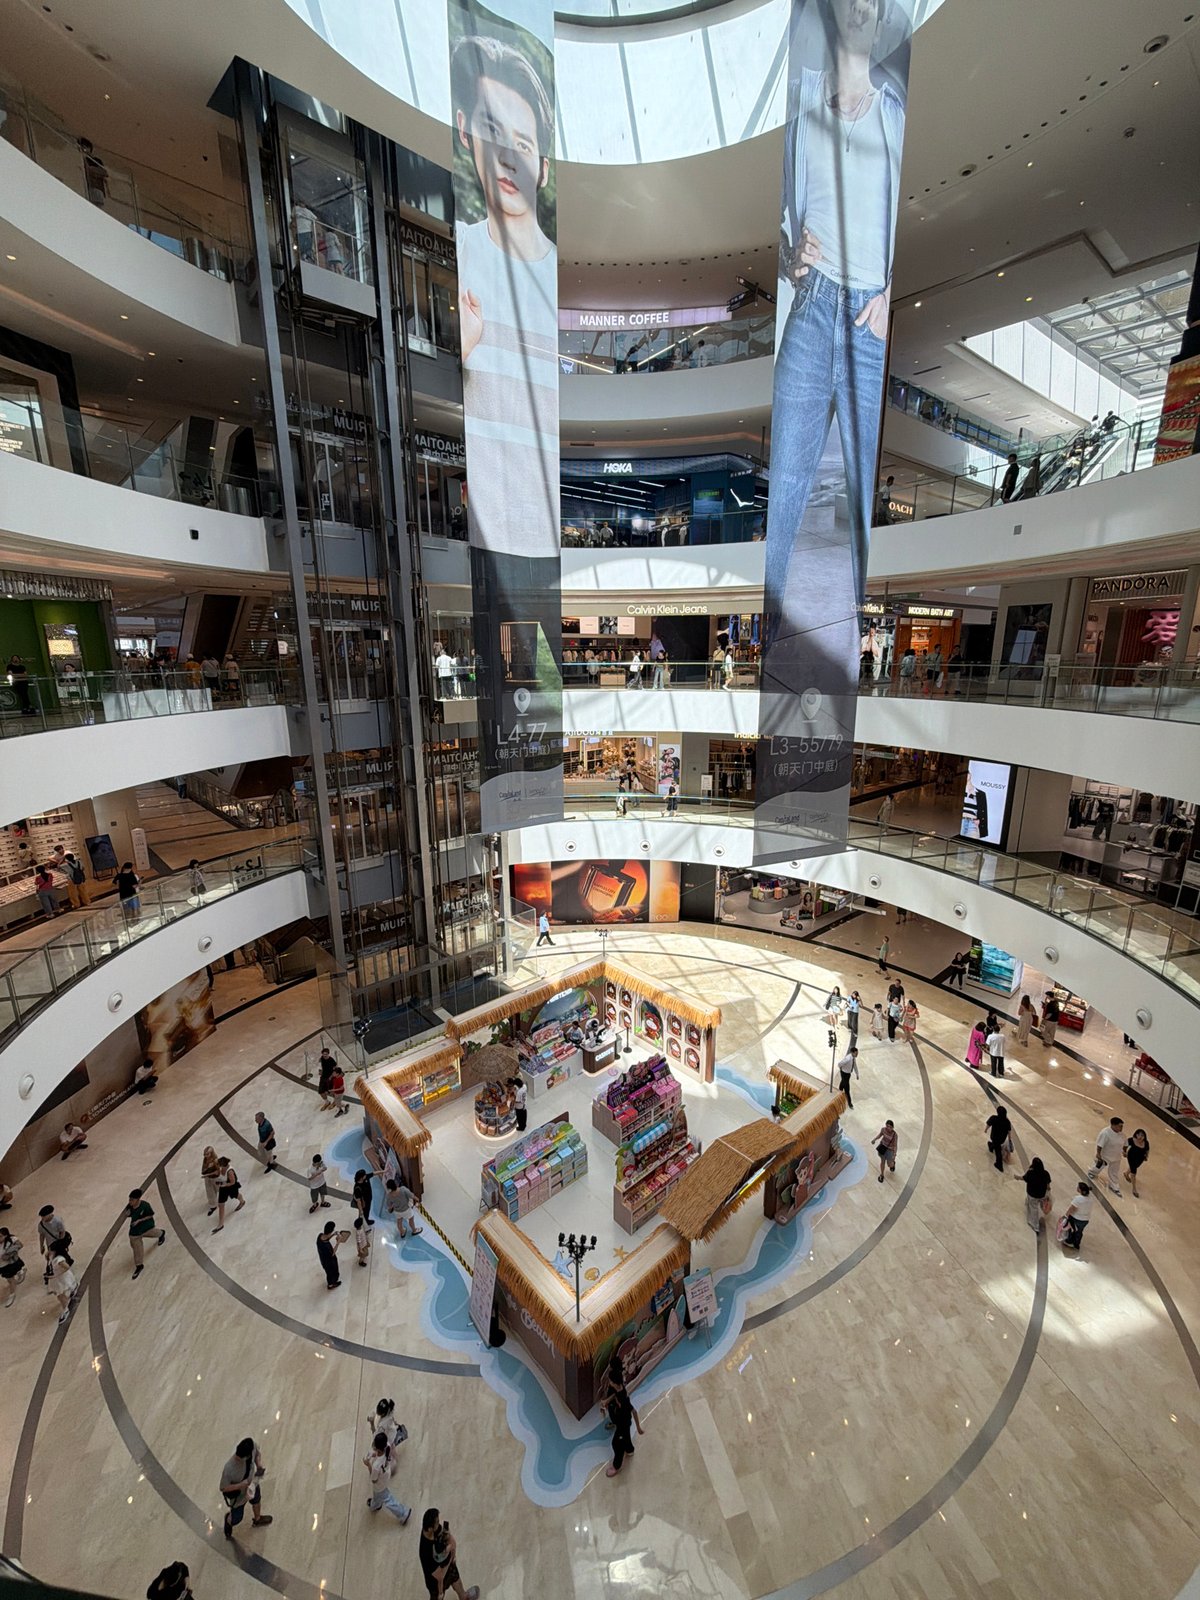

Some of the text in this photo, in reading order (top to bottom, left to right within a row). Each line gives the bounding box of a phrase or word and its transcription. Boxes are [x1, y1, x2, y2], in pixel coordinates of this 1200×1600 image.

[580, 312, 669, 326] MANNER COFFEE
[603, 462, 633, 473] HOKA
[888, 502, 912, 515] OACH
[1092, 576, 1170, 594] PANDORA
[627, 604, 707, 614] Calvin Klein Jeans
[908, 606, 930, 615] MODERN
[930, 608, 943, 616] BATH
[944, 608, 954, 616] ART
[497, 722, 548, 745] L4-77
[770, 734, 844, 756] L3-55/79
[774, 759, 838, 776] (朝天门中庭)
[980, 780, 1006, 790] MOUSSY
